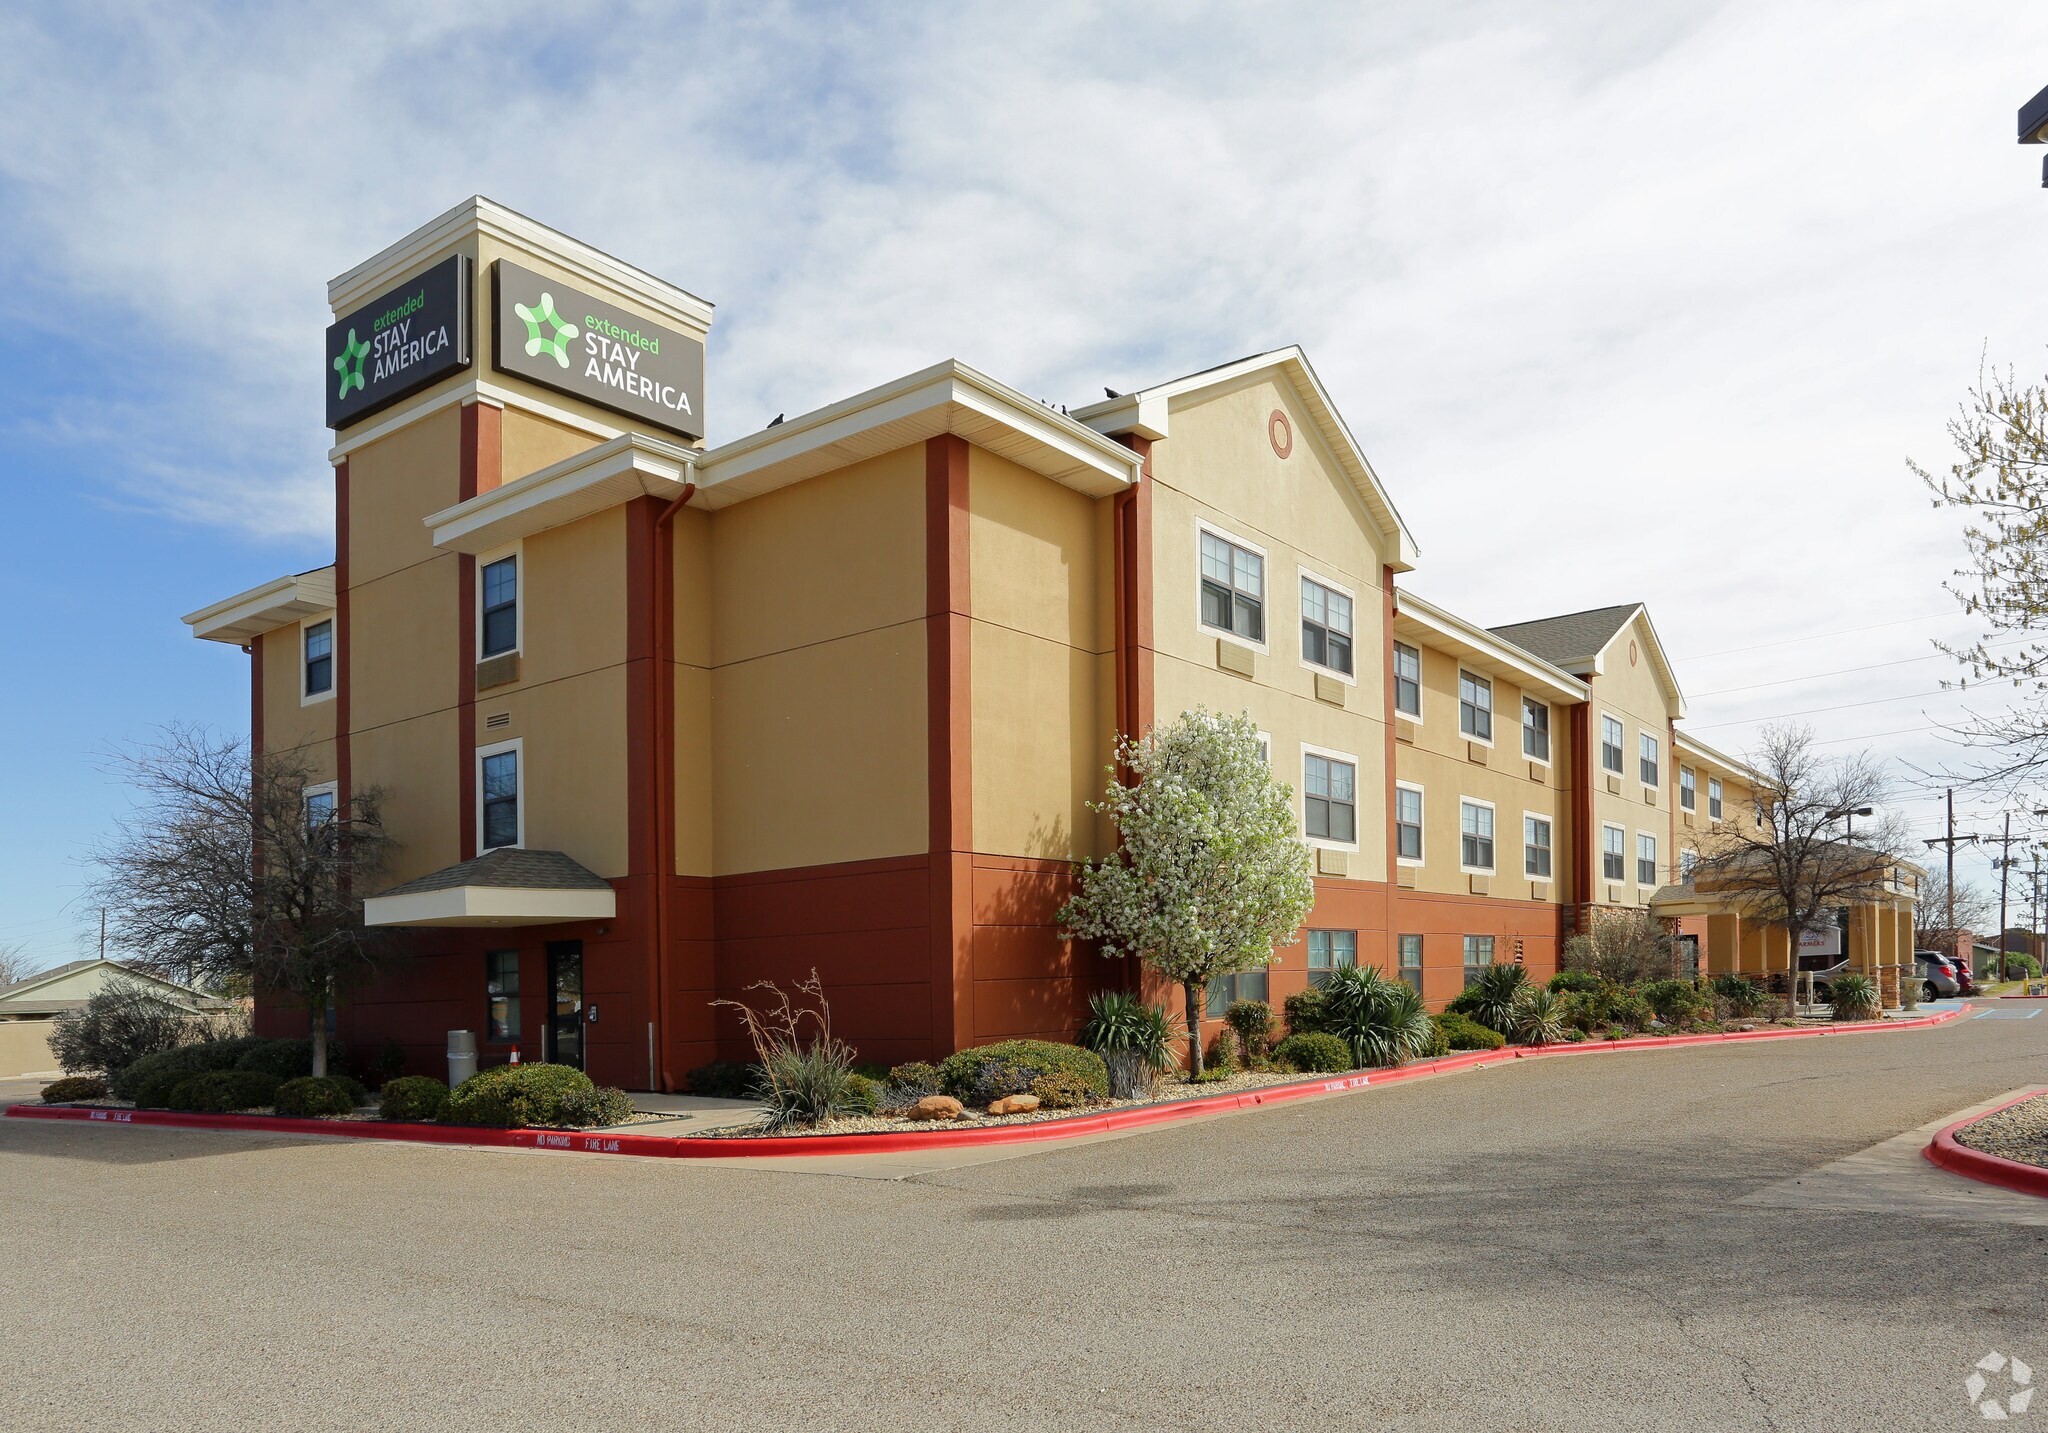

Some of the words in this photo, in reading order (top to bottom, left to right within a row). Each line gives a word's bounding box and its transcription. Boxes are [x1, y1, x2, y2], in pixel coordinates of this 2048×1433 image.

[373, 289, 424, 332] extended
[373, 318, 411, 358] STAY
[373, 325, 449, 384] AMERICA
[584, 314, 660, 355] extended
[585, 331, 641, 371] STAY
[584, 357, 693, 416] AMERICA
[537, 1134, 545, 1146] NO
[585, 1138, 601, 1151] FIRE
[603, 1139, 620, 1151] LANE
